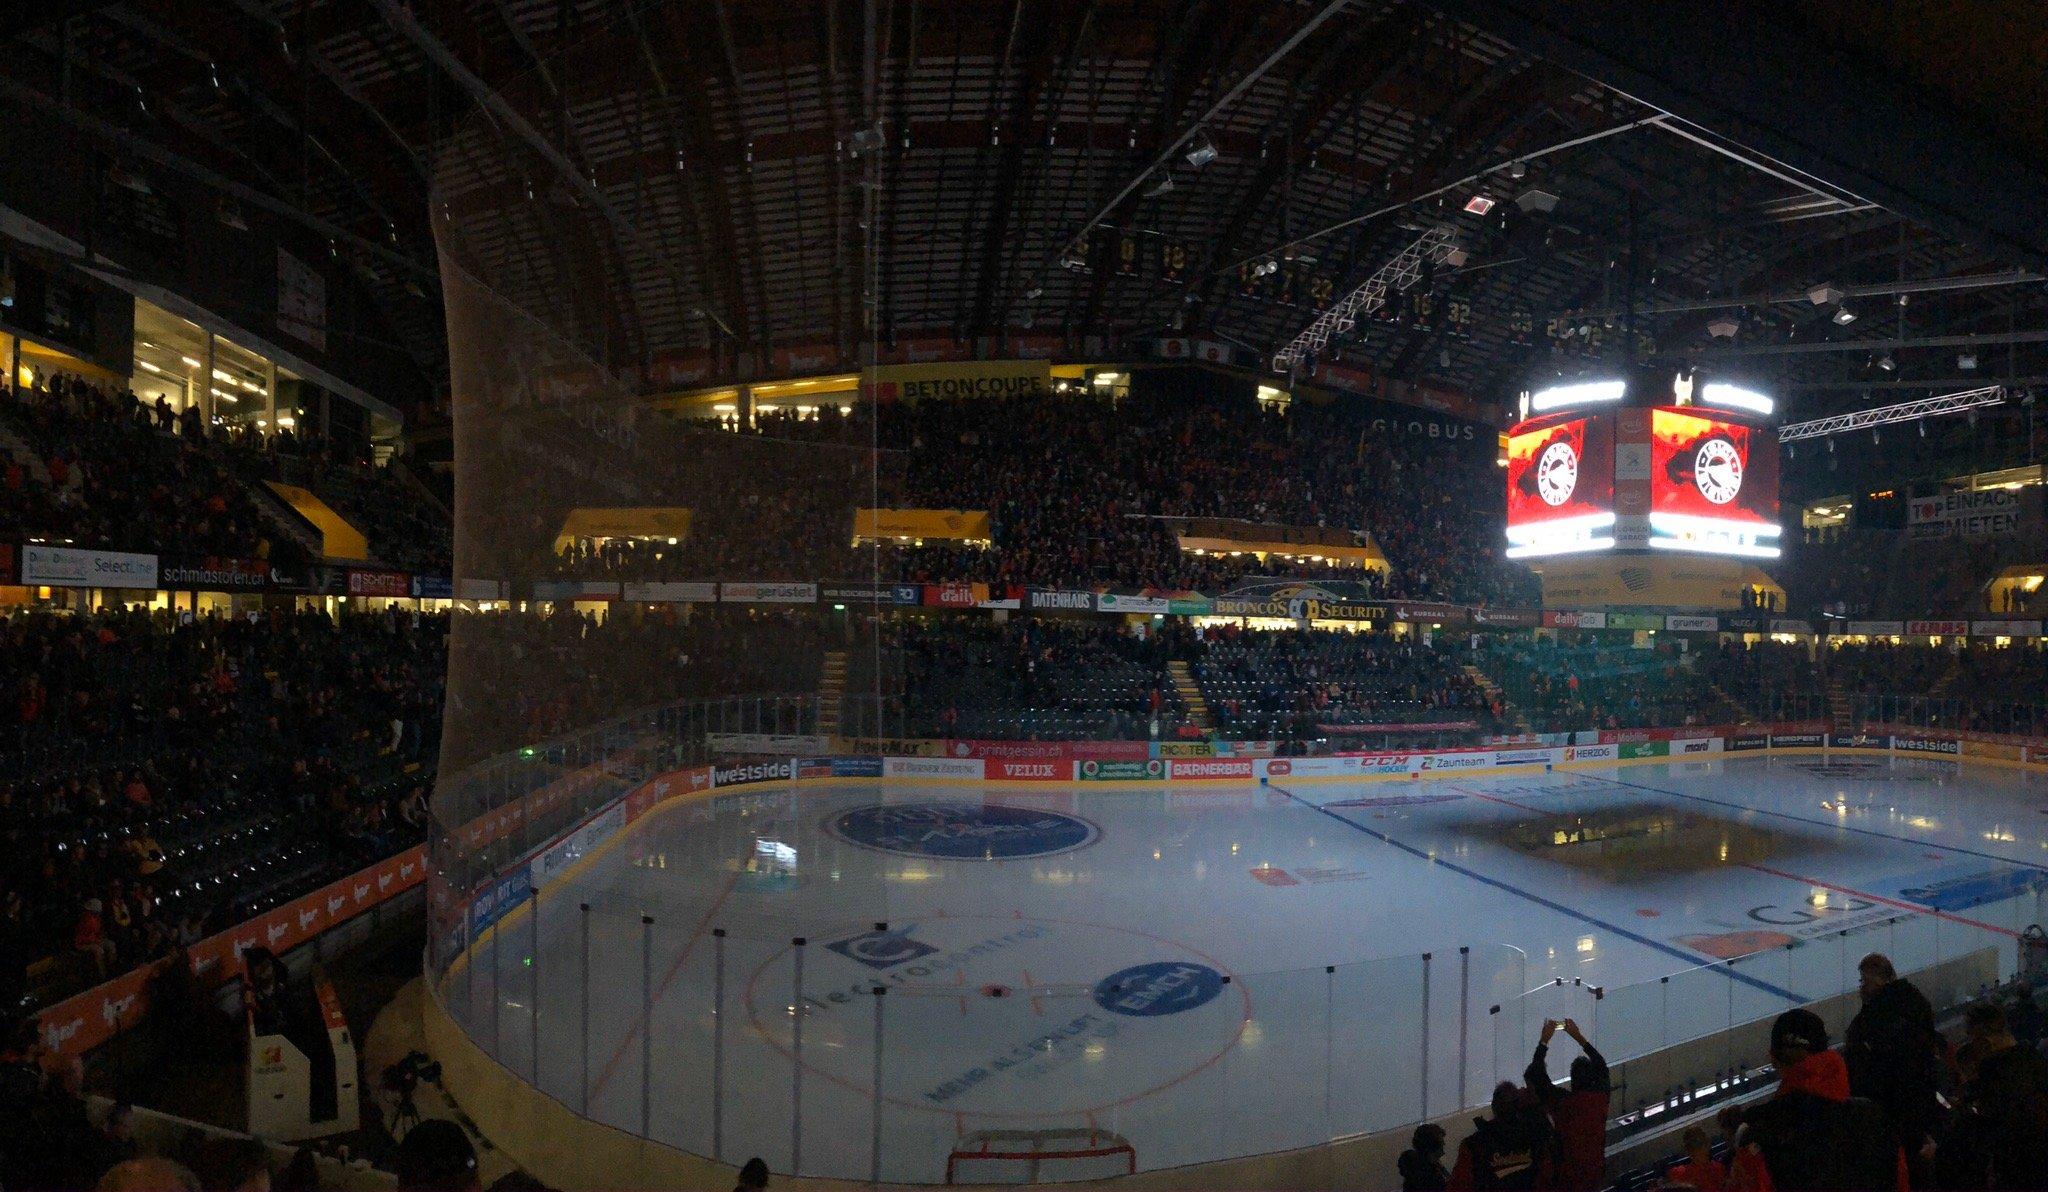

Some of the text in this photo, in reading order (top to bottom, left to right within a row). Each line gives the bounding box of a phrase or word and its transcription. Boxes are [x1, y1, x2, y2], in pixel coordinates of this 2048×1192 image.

[904, 376, 1041, 396] BETONCOUPE
[1372, 418, 1476, 442] GLOBUS
[1032, 592, 1090, 609] DATENHAUS
[1216, 601, 1287, 614] BRONCOS
[1321, 603, 1387, 618] SECURITY
[1672, 617, 1704, 628] gruner
[979, 743, 1063, 758] printgessin.ch
[1160, 744, 1212, 755] RICOTER
[1576, 747, 1610, 758] HERZOG
[1895, 739, 1957, 753] westside
[1360, 756, 1410, 767] CCM
[1436, 756, 1486, 768] Zaunteam
[715, 762, 791, 784] westside
[1004, 764, 1056, 777] VELUX
